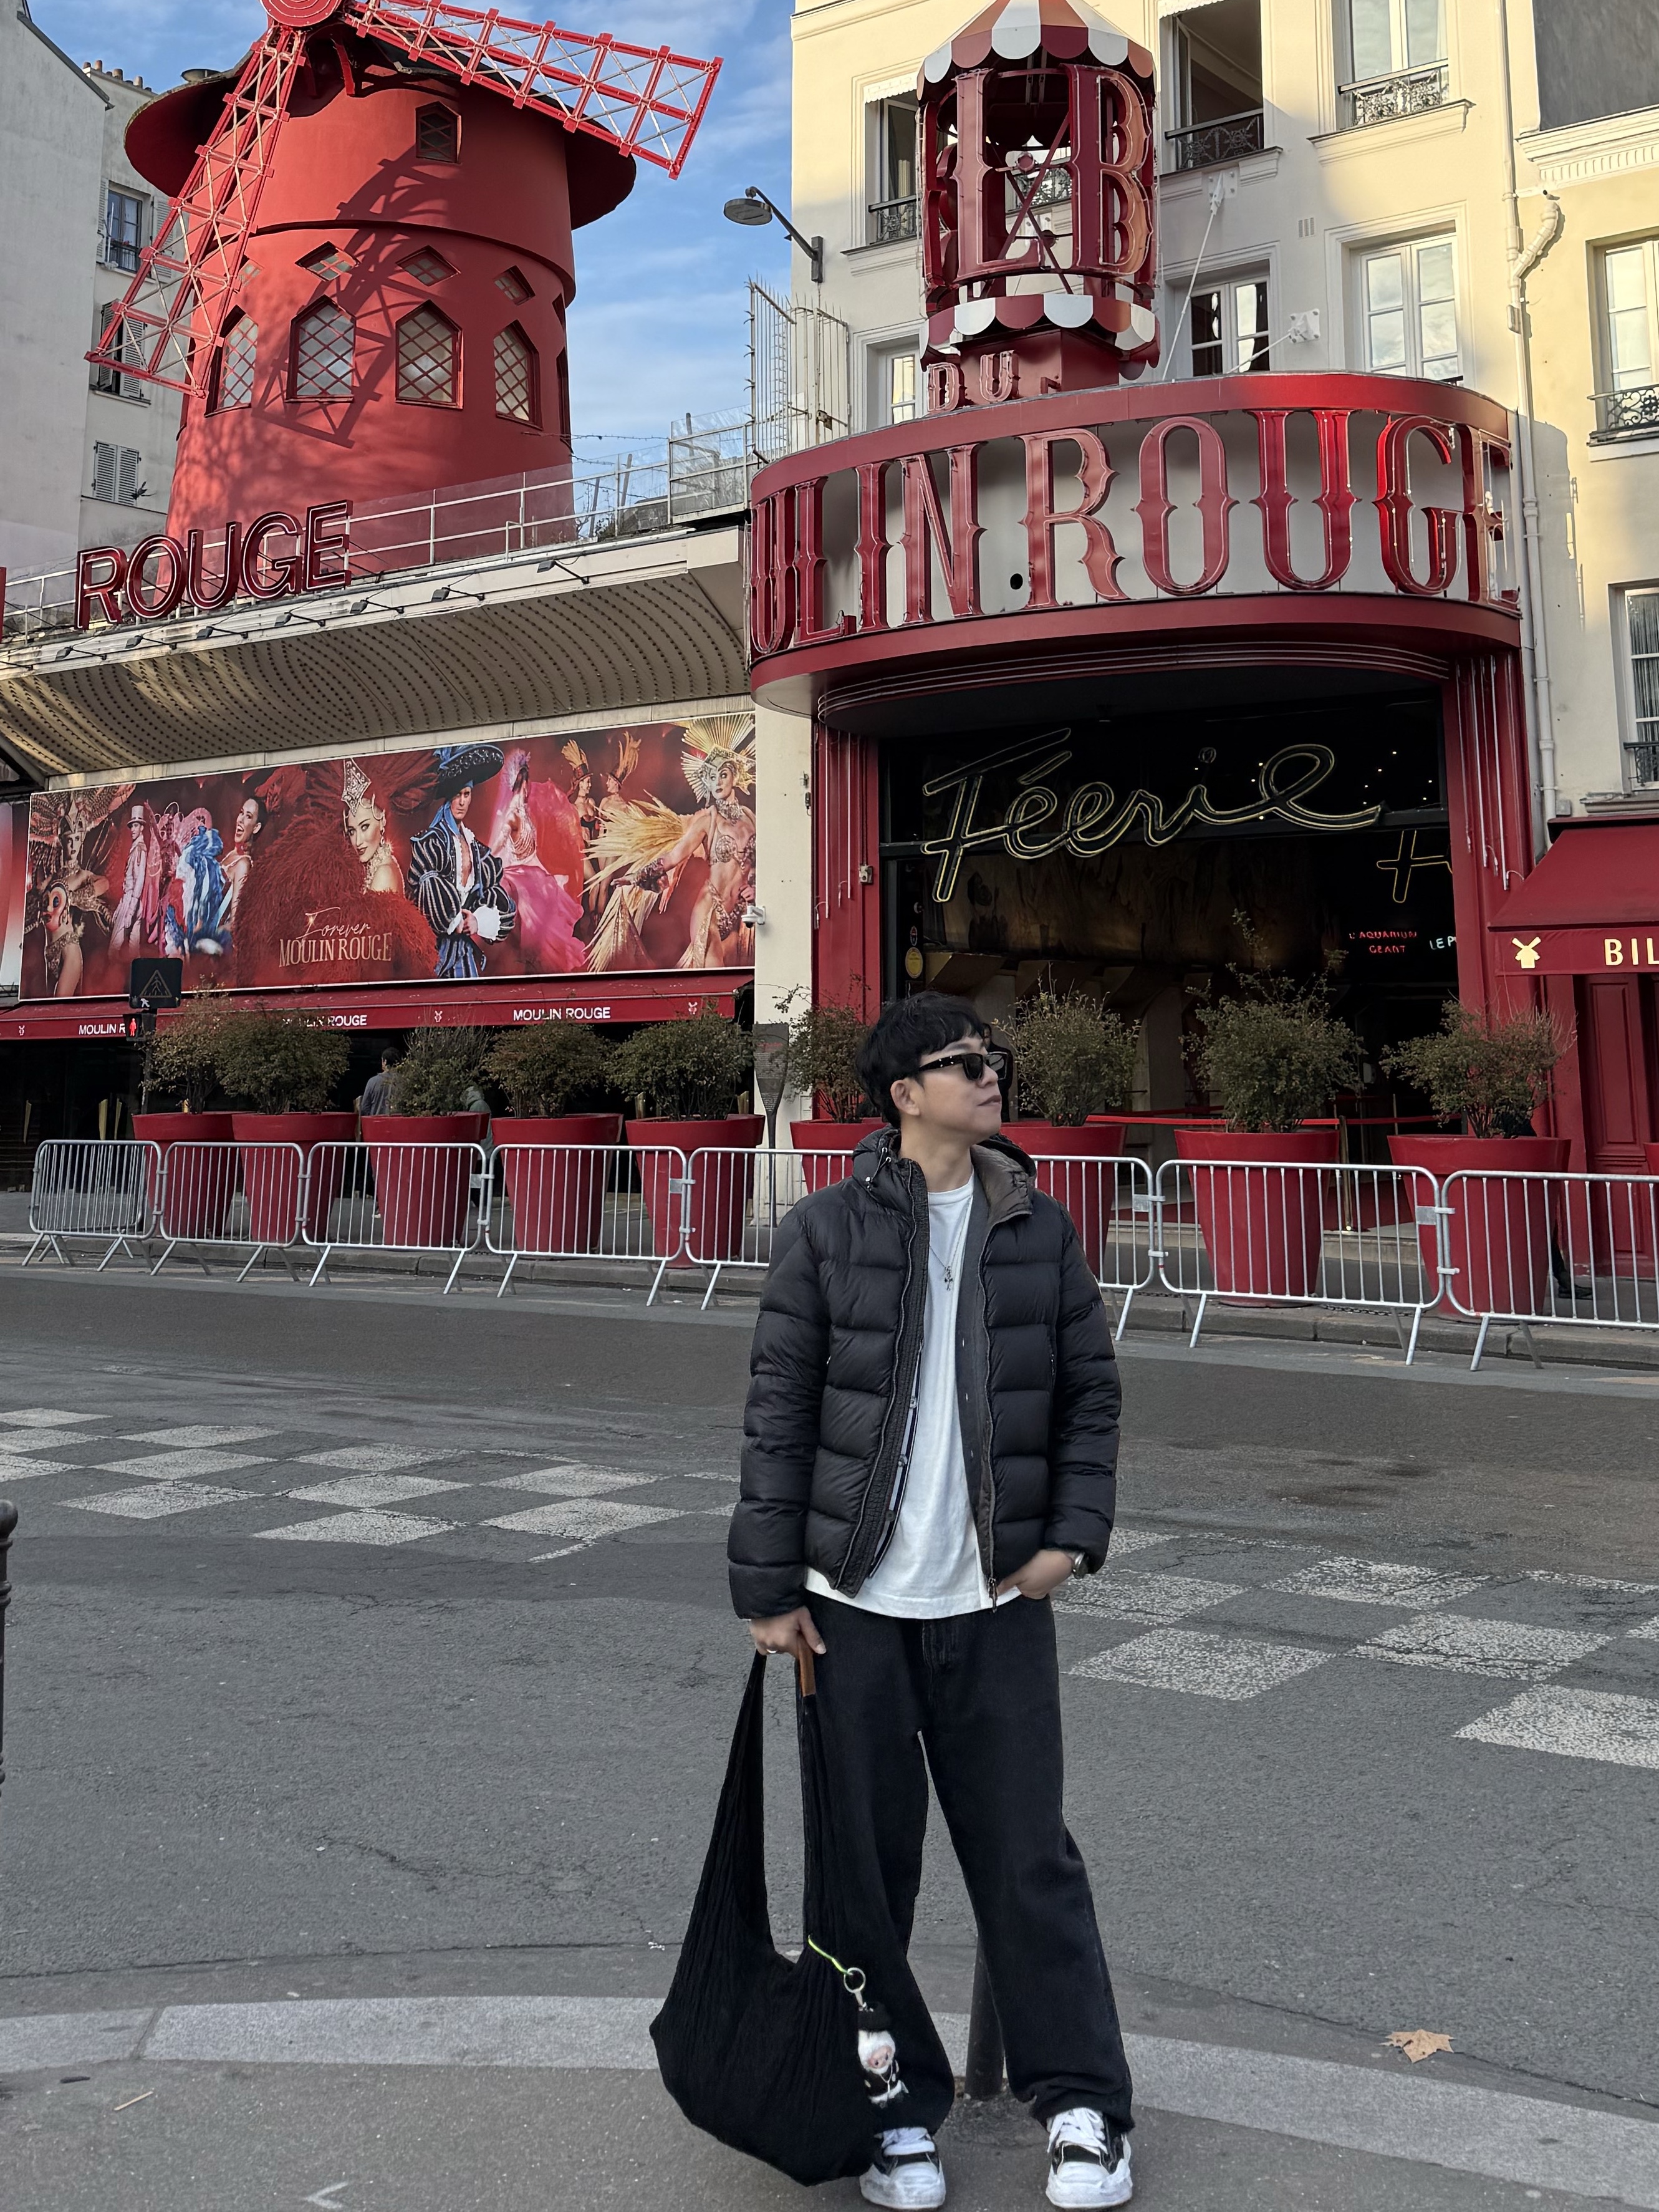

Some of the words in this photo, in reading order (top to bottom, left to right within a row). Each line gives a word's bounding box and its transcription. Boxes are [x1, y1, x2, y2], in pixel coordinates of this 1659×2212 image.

[1017, 409, 1522, 617] ROUGE
[76, 500, 353, 630] ROUGE
[296, 907, 371, 940] Forever
[279, 938, 334, 967] MOULIN
[338, 932, 392, 961] ROUGE
[79, 1024, 117, 1035] MOULIN
[513, 1008, 561, 1021] MOULIN
[565, 1007, 610, 1019] ROUGE
